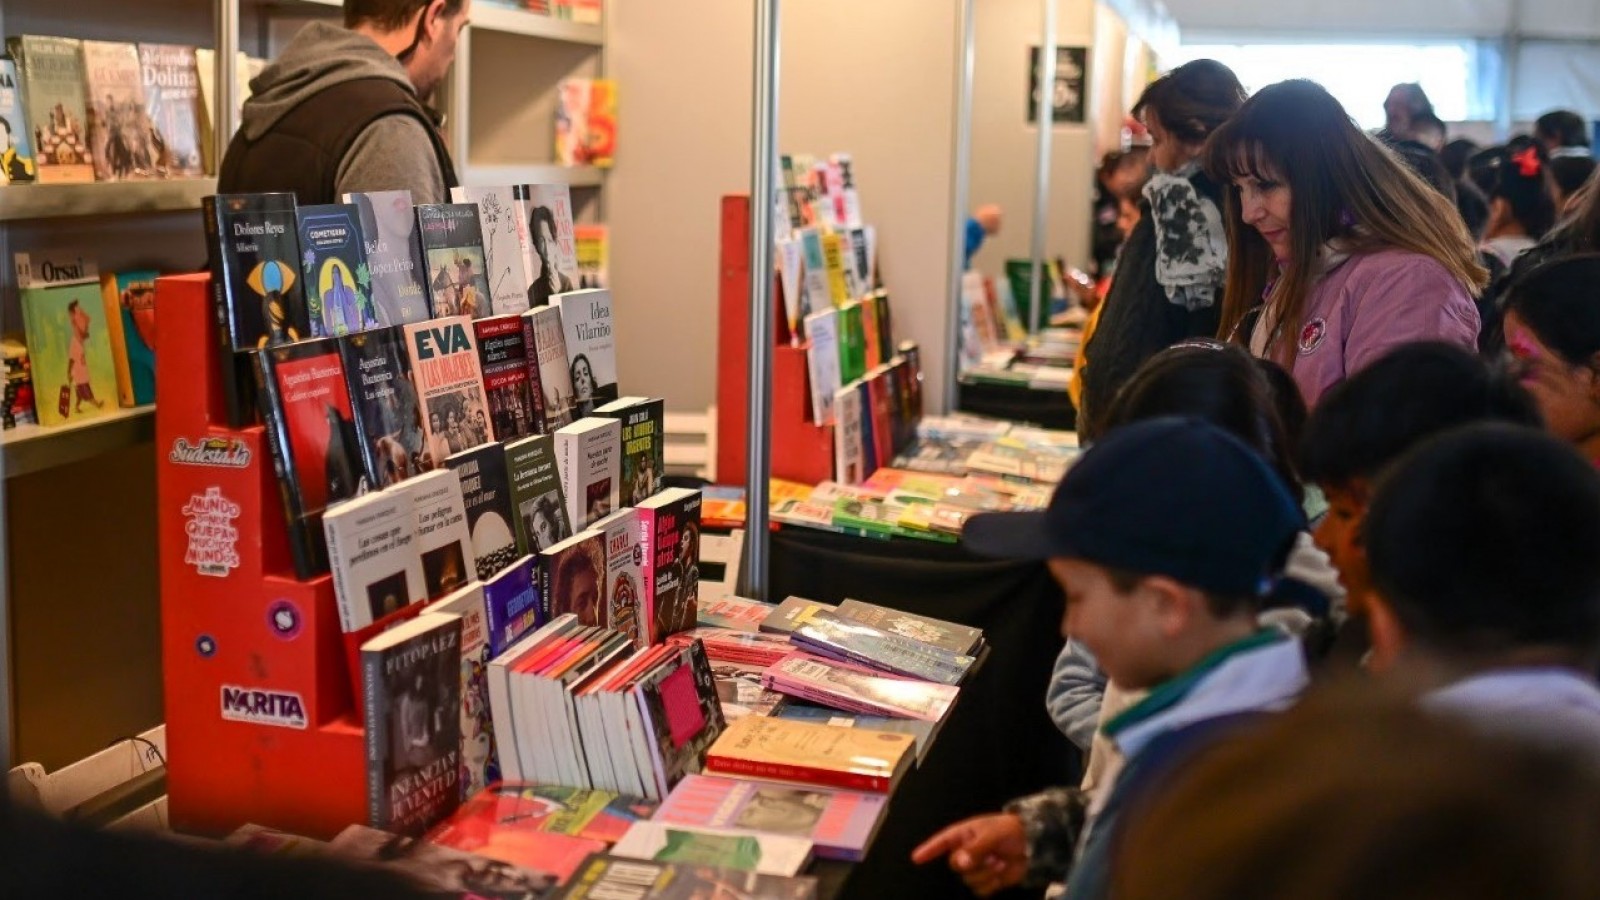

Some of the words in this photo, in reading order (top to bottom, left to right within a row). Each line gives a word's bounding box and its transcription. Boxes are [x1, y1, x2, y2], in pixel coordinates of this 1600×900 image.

[234, 222, 264, 236] Dolores
[264, 220, 285, 238] Reyes
[41, 258, 85, 282] Orsai
[590, 301, 610, 320] Idea
[575, 321, 612, 341] Vilariño
[414, 323, 471, 361] EVA
[187, 497, 239, 517] MUNDO
[186, 521, 235, 540] QUEPAN
[187, 550, 238, 567] MUNDOS
